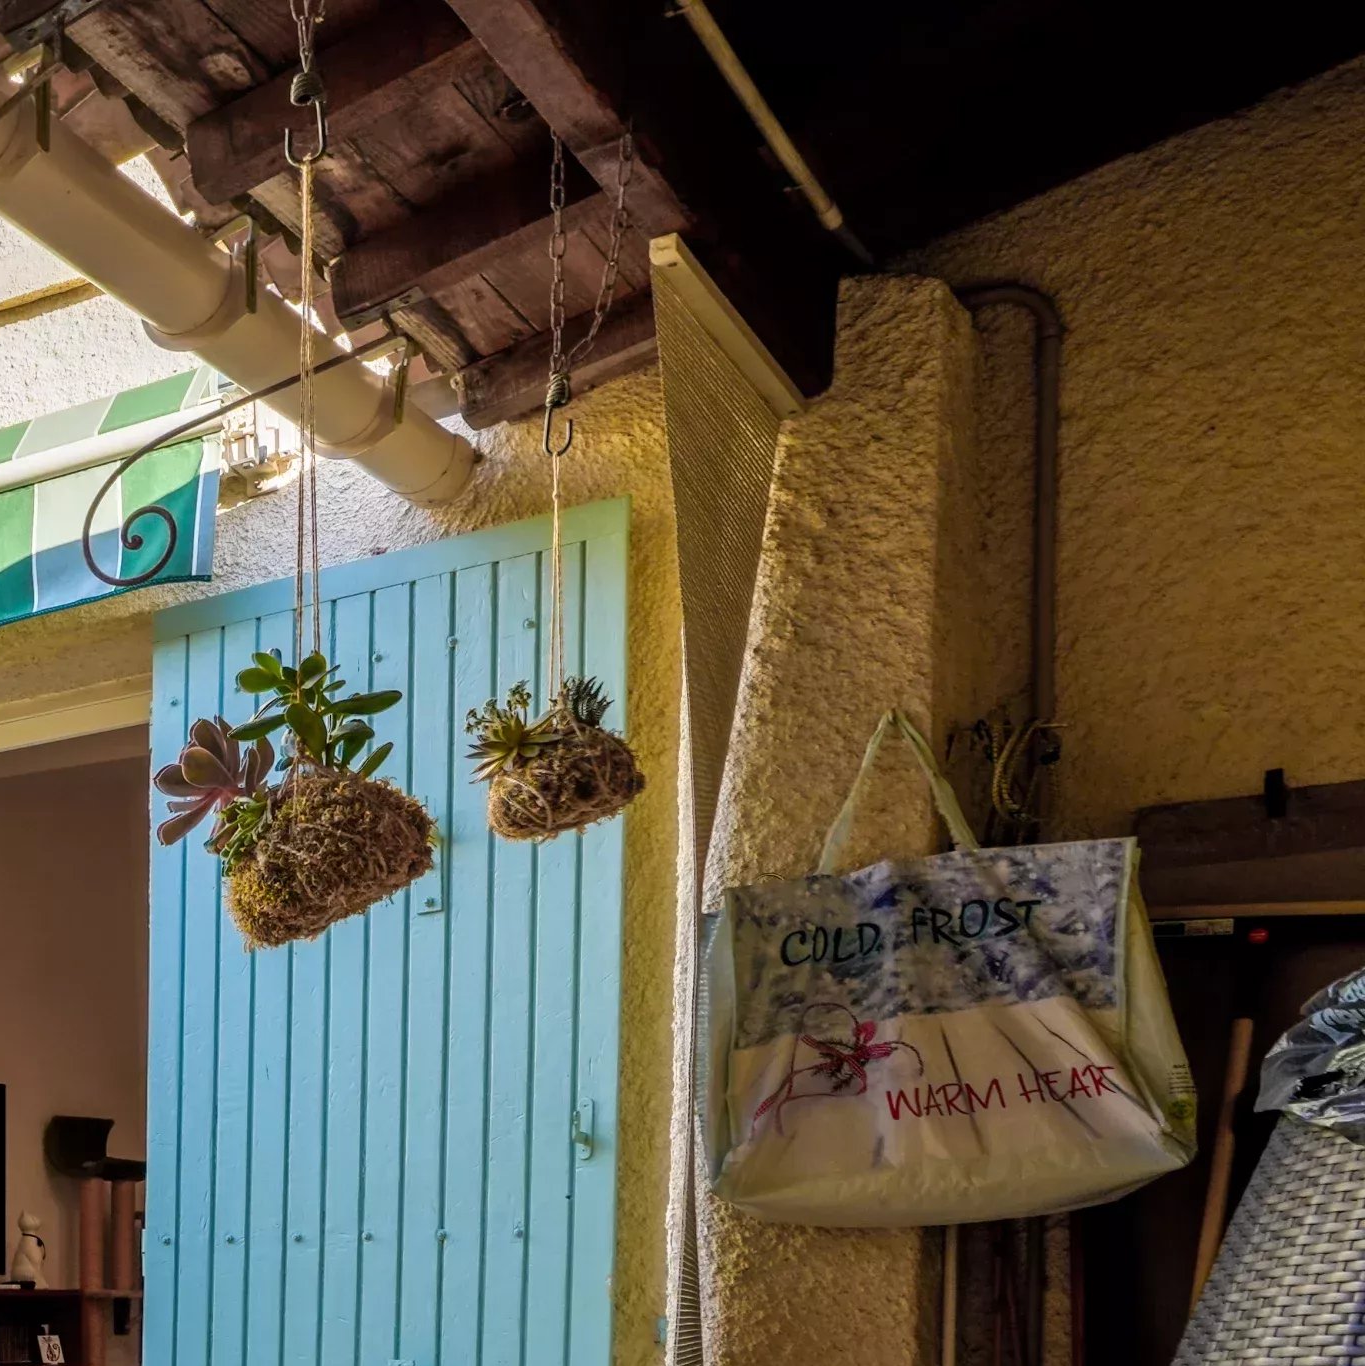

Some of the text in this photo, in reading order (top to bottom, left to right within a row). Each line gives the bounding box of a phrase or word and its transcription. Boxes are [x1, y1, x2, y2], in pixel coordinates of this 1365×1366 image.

[780, 896, 1042, 967] COLD FROST
[885, 1077, 1006, 1121] WARM
